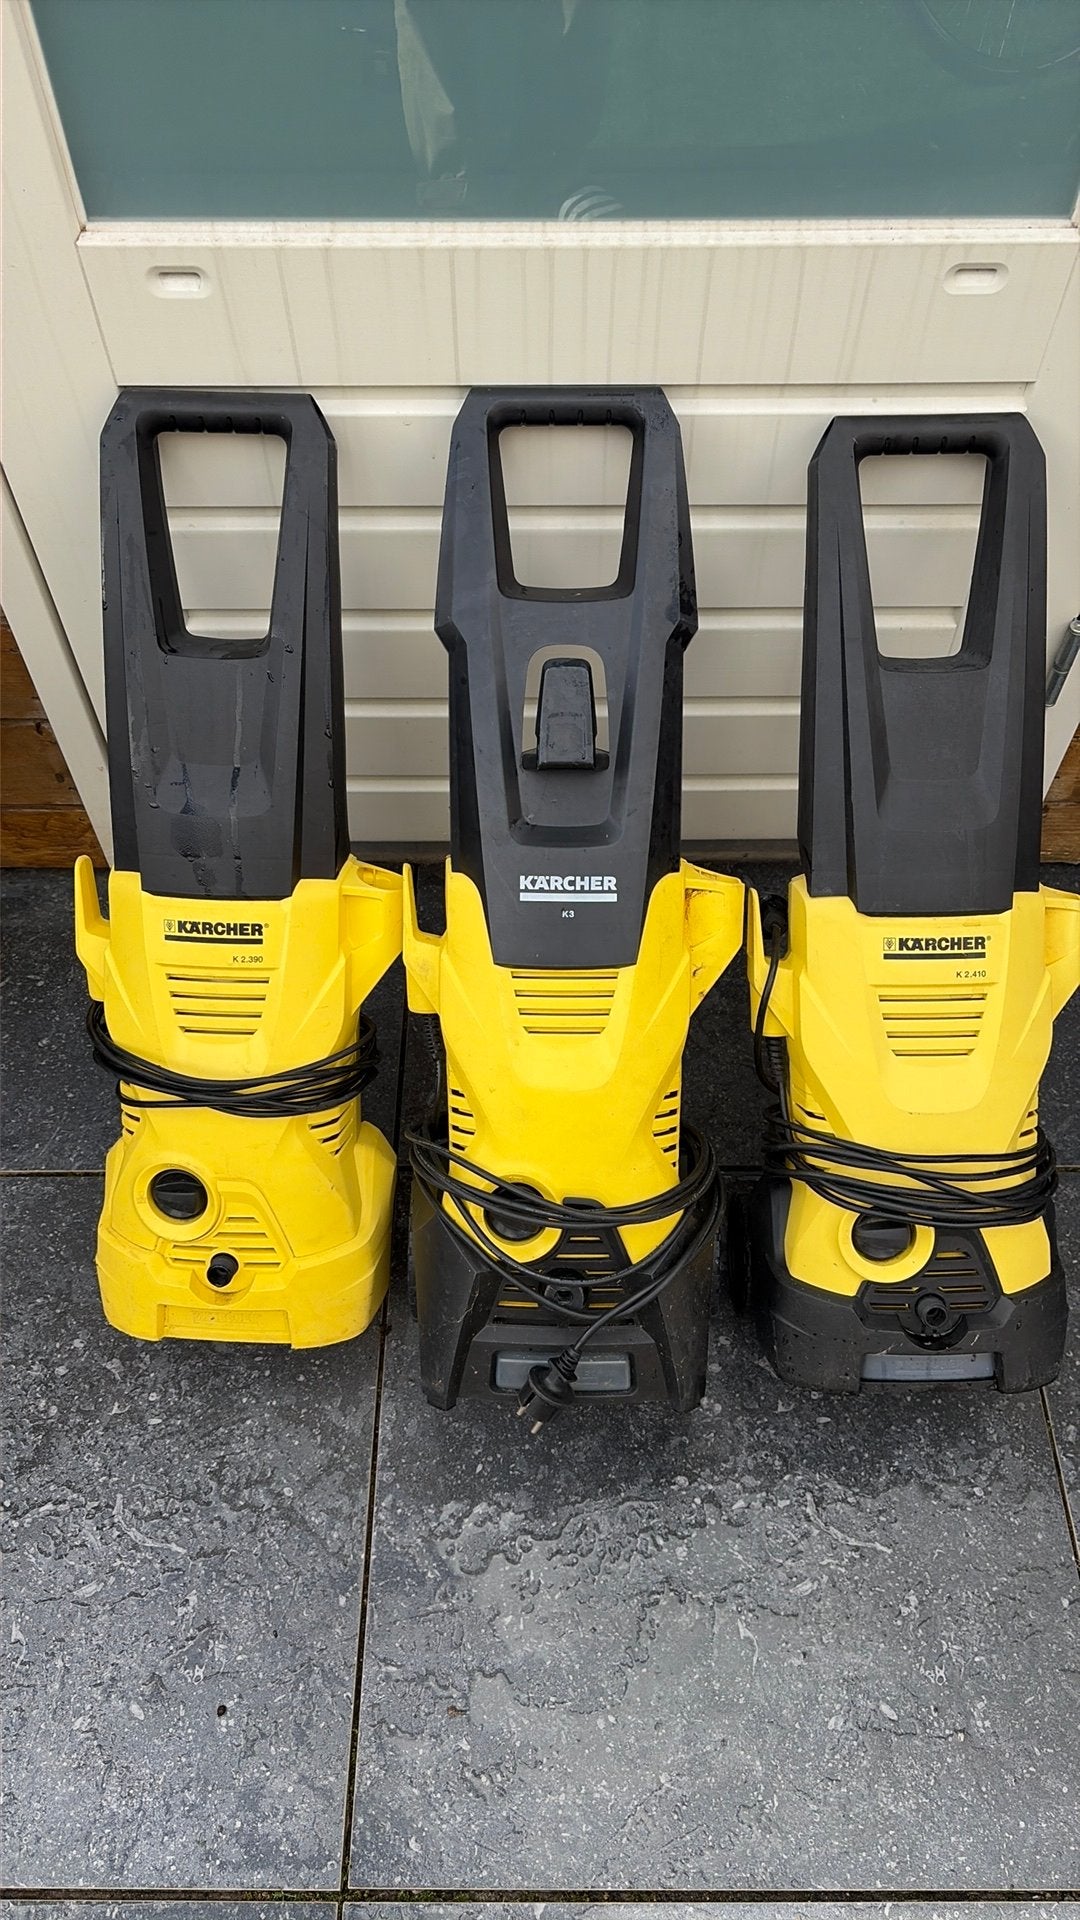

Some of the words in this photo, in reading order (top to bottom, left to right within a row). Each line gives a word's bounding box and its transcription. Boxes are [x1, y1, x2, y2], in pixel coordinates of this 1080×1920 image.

[519, 875, 618, 891] KÄRCHER
[561, 910, 575, 918] K3
[177, 920, 263, 936] KÄRCHER
[898, 936, 986, 951] KÄRCHER
[232, 955, 239, 963] K
[240, 955, 264, 963] 2.390
[956, 970, 962, 979] K
[964, 970, 987, 978] 2.410
